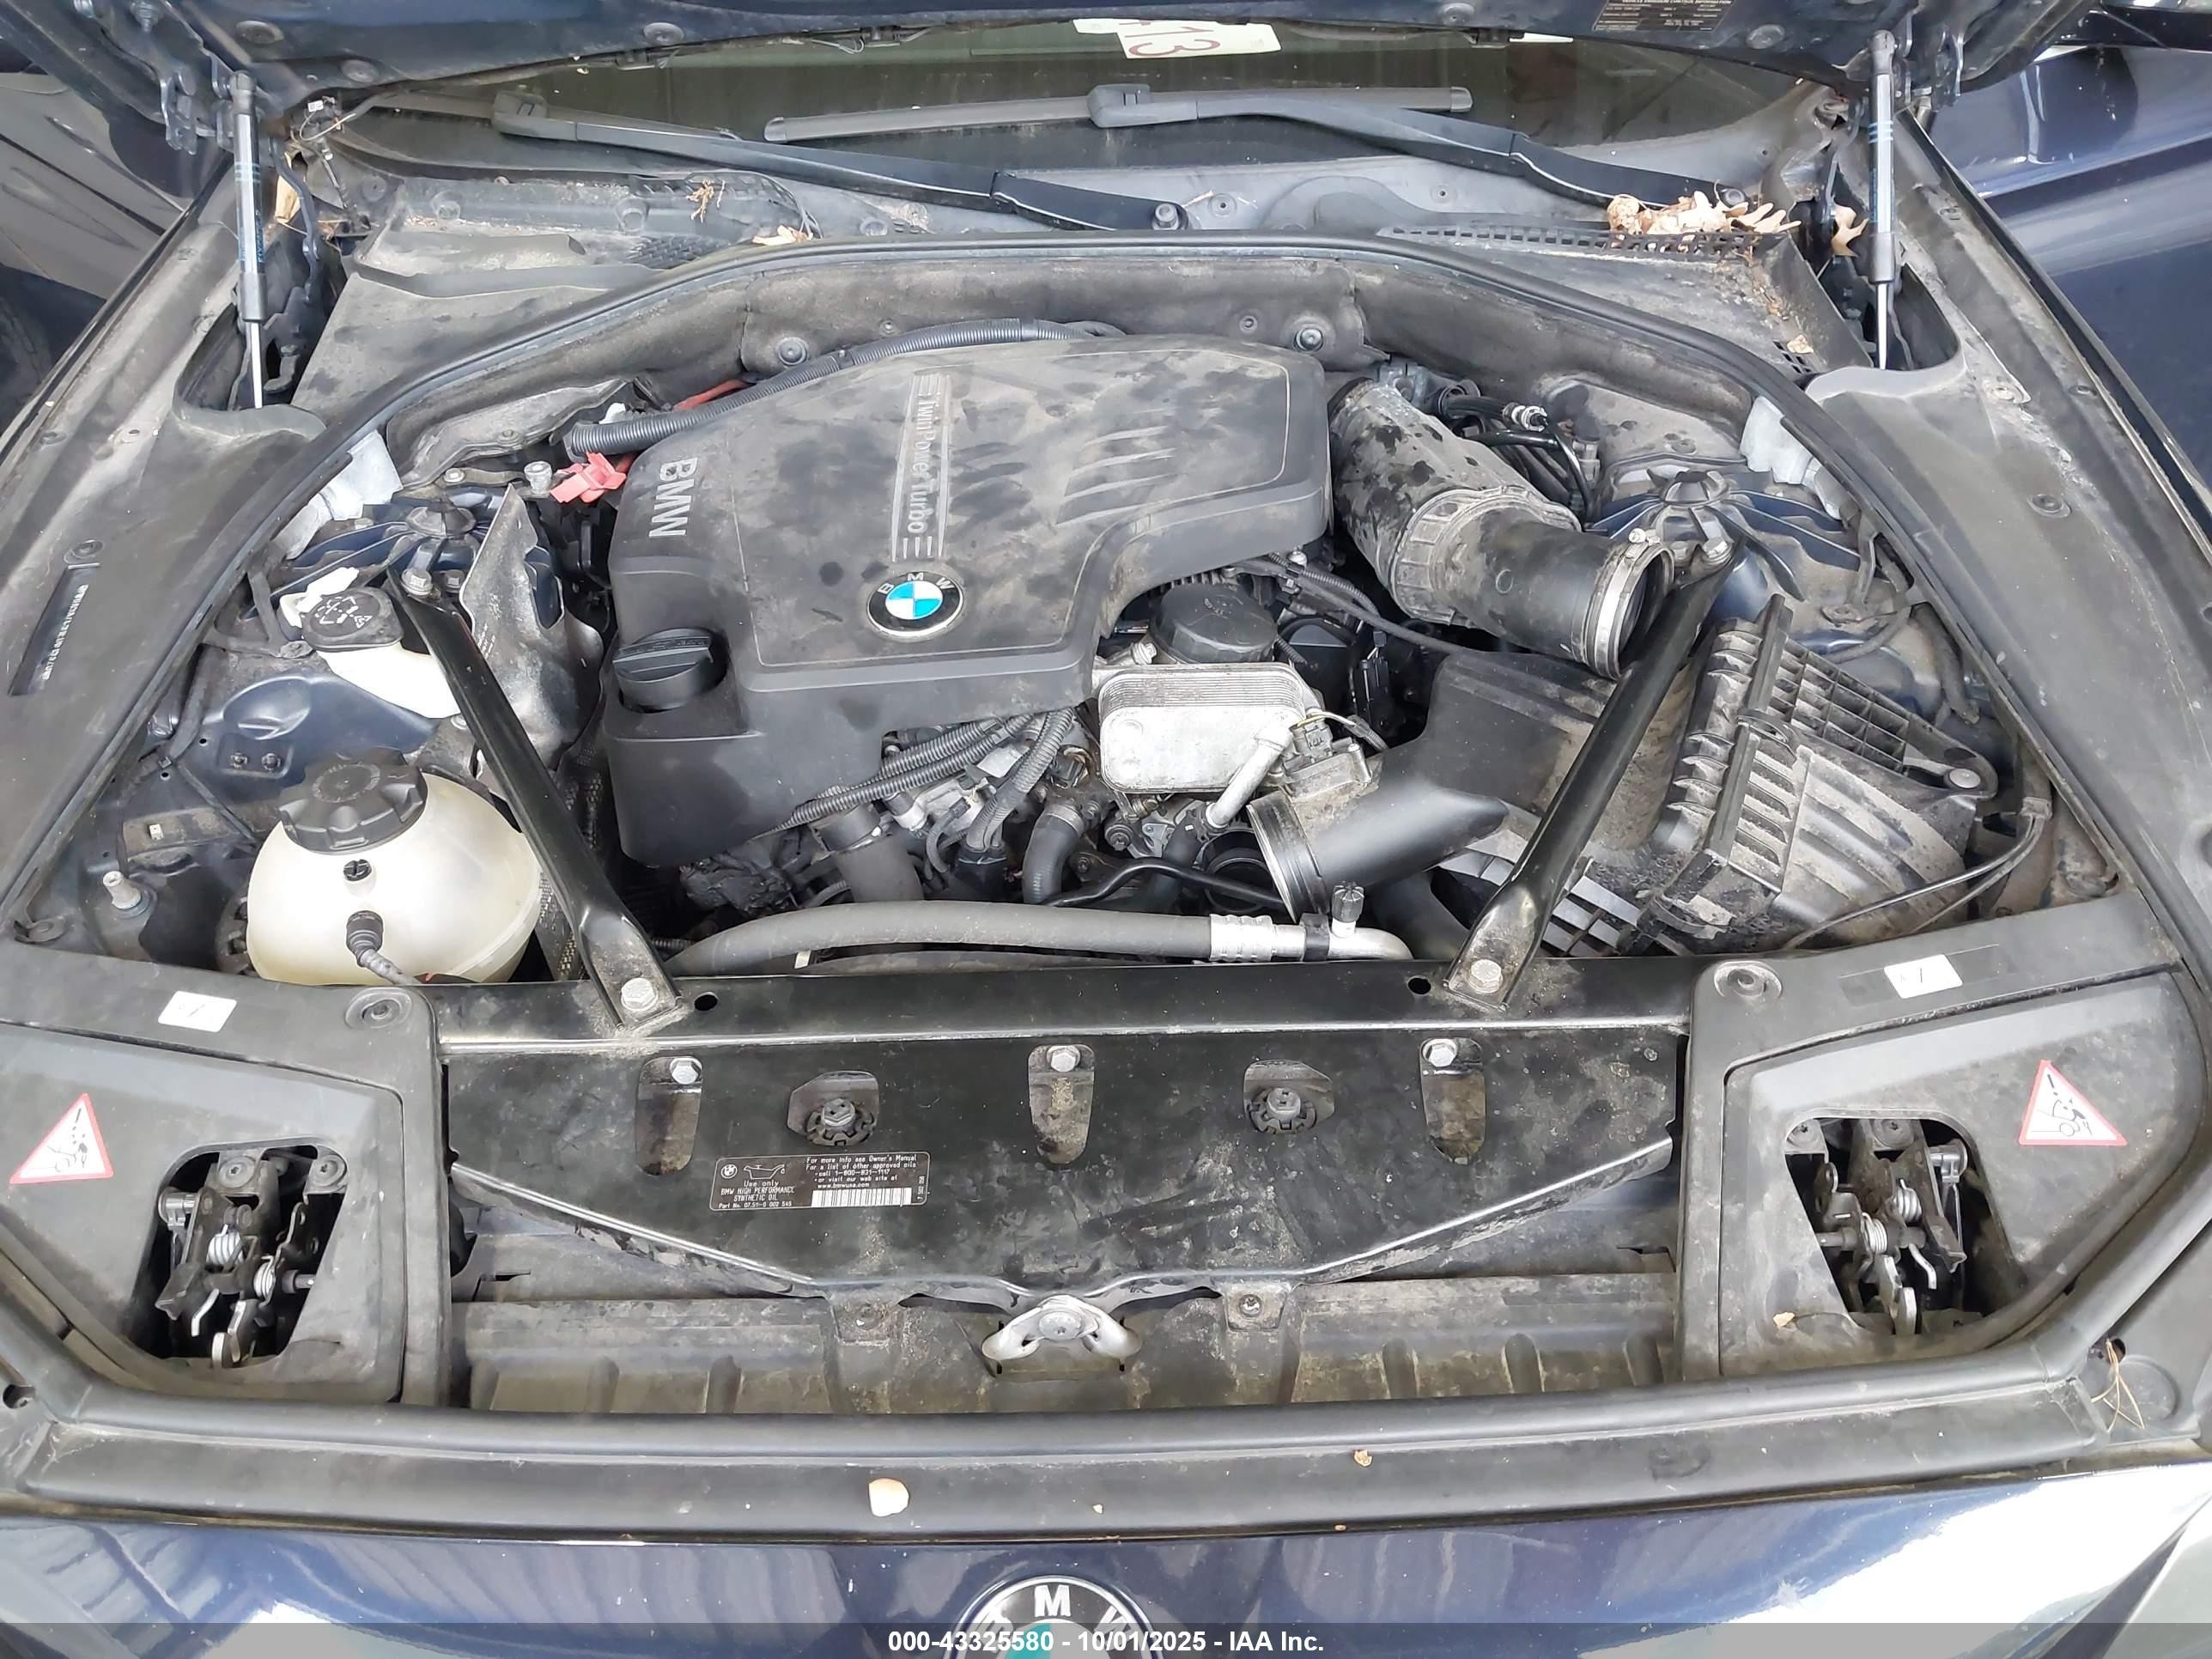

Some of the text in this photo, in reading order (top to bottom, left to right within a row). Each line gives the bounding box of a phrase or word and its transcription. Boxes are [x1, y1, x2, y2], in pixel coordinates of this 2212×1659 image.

[648, 458, 698, 537] BMW
[878, 572, 956, 594] BMW
[754, 1186, 795, 1194] PERFORMANCE
[762, 1179, 780, 1188] only
